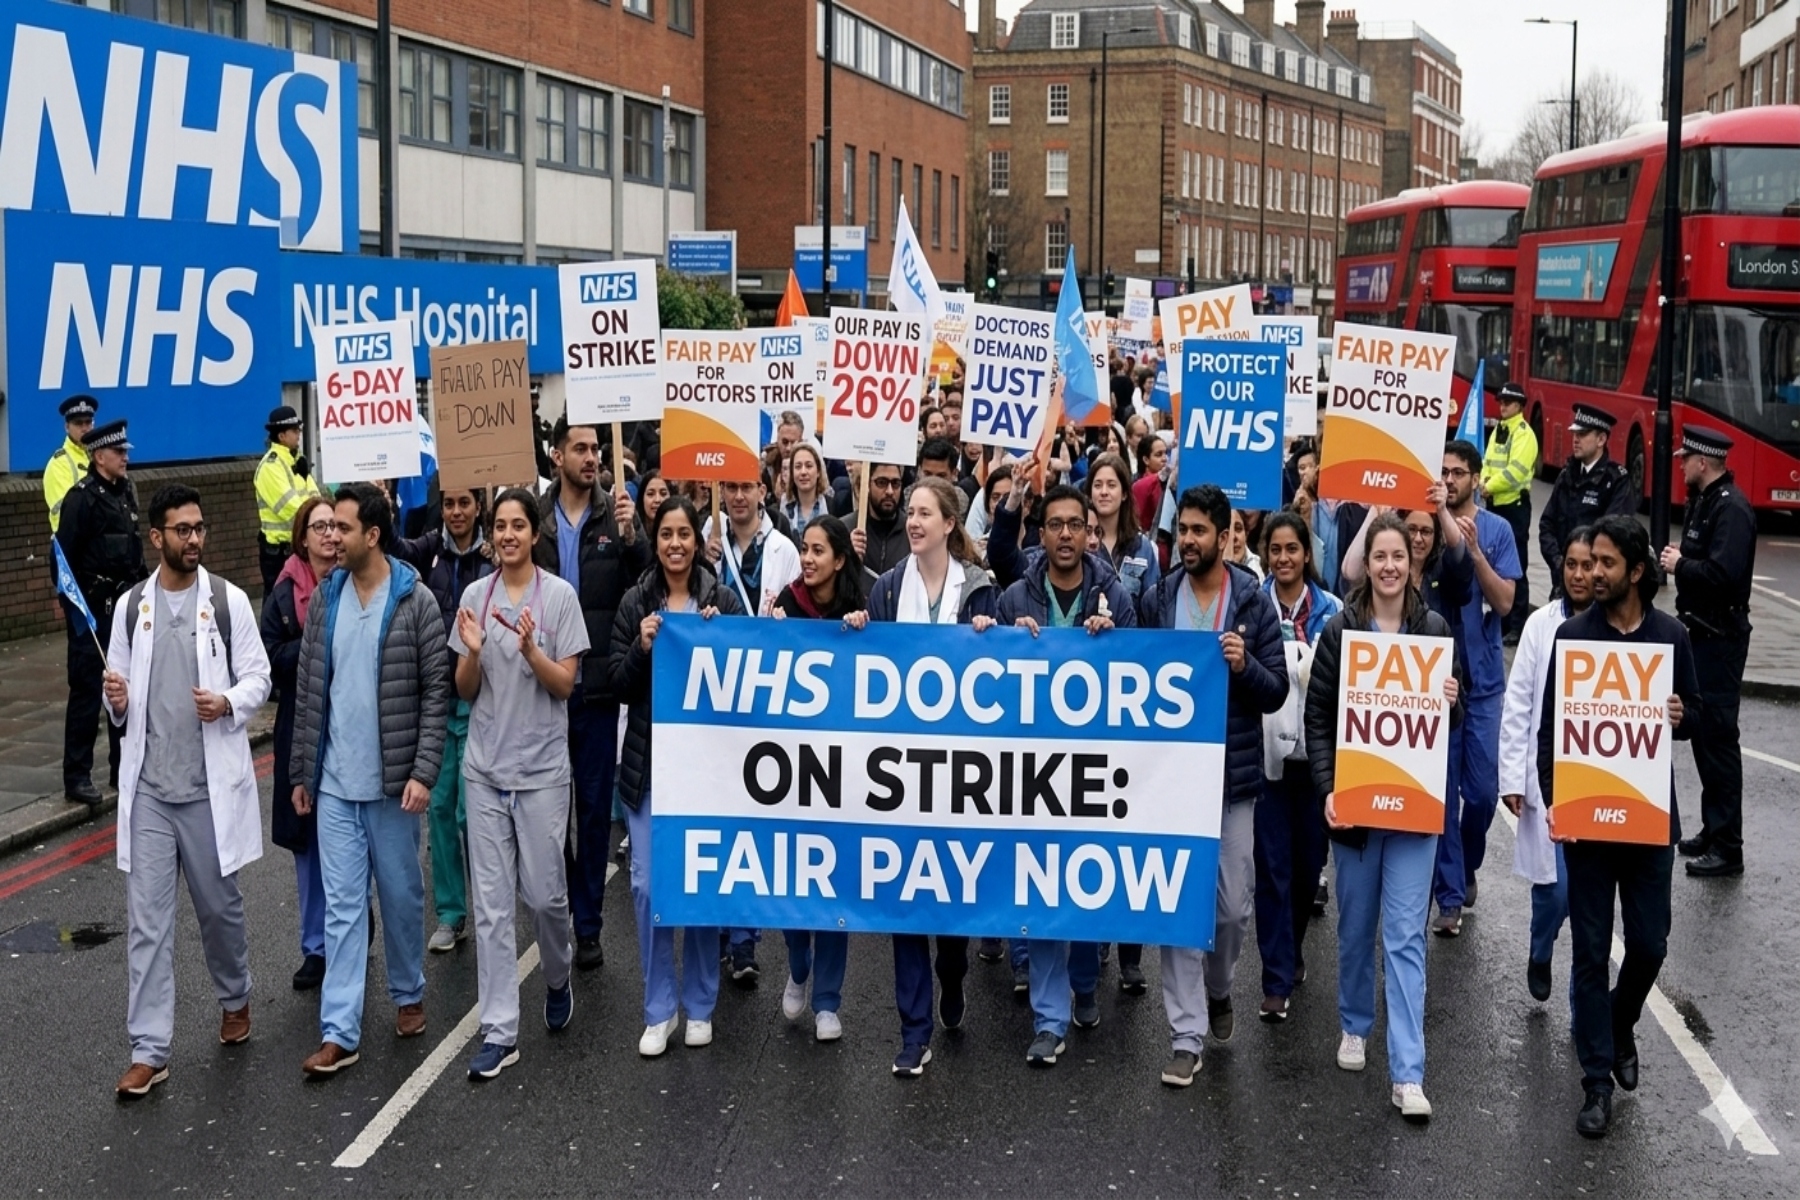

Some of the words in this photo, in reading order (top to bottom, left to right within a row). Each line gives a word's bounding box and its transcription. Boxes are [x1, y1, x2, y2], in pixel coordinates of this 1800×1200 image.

[0, 23, 329, 247] NHS
[1739, 258, 1786, 274] London
[583, 274, 633, 300] NHS
[39, 262, 258, 389] NHS
[395, 286, 537, 347] Hospital
[592, 309, 628, 336] ON
[835, 316, 868, 336] OUR
[873, 320, 902, 338] PAY
[906, 322, 920, 340] IS
[975, 315, 1050, 339] DOCTORS
[1177, 295, 1236, 336] PAY
[339, 335, 389, 361] NHS
[762, 337, 800, 356] NHS
[1263, 325, 1300, 345] NHS
[567, 339, 656, 370] STRIKE
[666, 340, 712, 362] FAIR
[718, 342, 756, 363] PAY
[834, 339, 919, 376] DOWN
[974, 338, 1048, 362] DEMAND
[1188, 352, 1280, 376] PROTECT
[1338, 335, 1394, 366] FAIR
[1401, 343, 1450, 372] PAY
[326, 366, 404, 398] 6-DAY
[492, 357, 524, 388] PAY
[698, 366, 725, 380] FOR
[768, 362, 794, 380] ON
[971, 364, 1045, 398] JUST
[1374, 370, 1407, 388] FOR
[666, 383, 756, 403] DOCTORS
[761, 384, 814, 403] TRIKE
[831, 373, 915, 422] 26%
[1210, 380, 1254, 401] OUR
[1332, 386, 1443, 420] DOCTORS
[324, 399, 412, 428] ACTION
[454, 398, 514, 434] DOWN
[970, 398, 1038, 439] PAY
[1184, 408, 1278, 452] NHS
[696, 452, 725, 466] NHS
[1362, 470, 1397, 489] NHS
[1347, 640, 1444, 693] PAY
[1564, 650, 1664, 702] PAY
[682, 646, 835, 717] NHS
[854, 654, 1196, 730] DOCTORS
[1347, 690, 1442, 712] RESTORATION
[1564, 702, 1664, 719] RESTORATION
[1345, 708, 1441, 750] NOW
[1562, 718, 1663, 760] NOW
[743, 741, 842, 808] ON
[865, 746, 1130, 820] STRIKE:
[1372, 794, 1404, 811] NHS
[1593, 807, 1627, 824] NHS
[684, 830, 837, 898] FAIR
[861, 837, 994, 904] PAY
[1014, 843, 1191, 914] NOW
